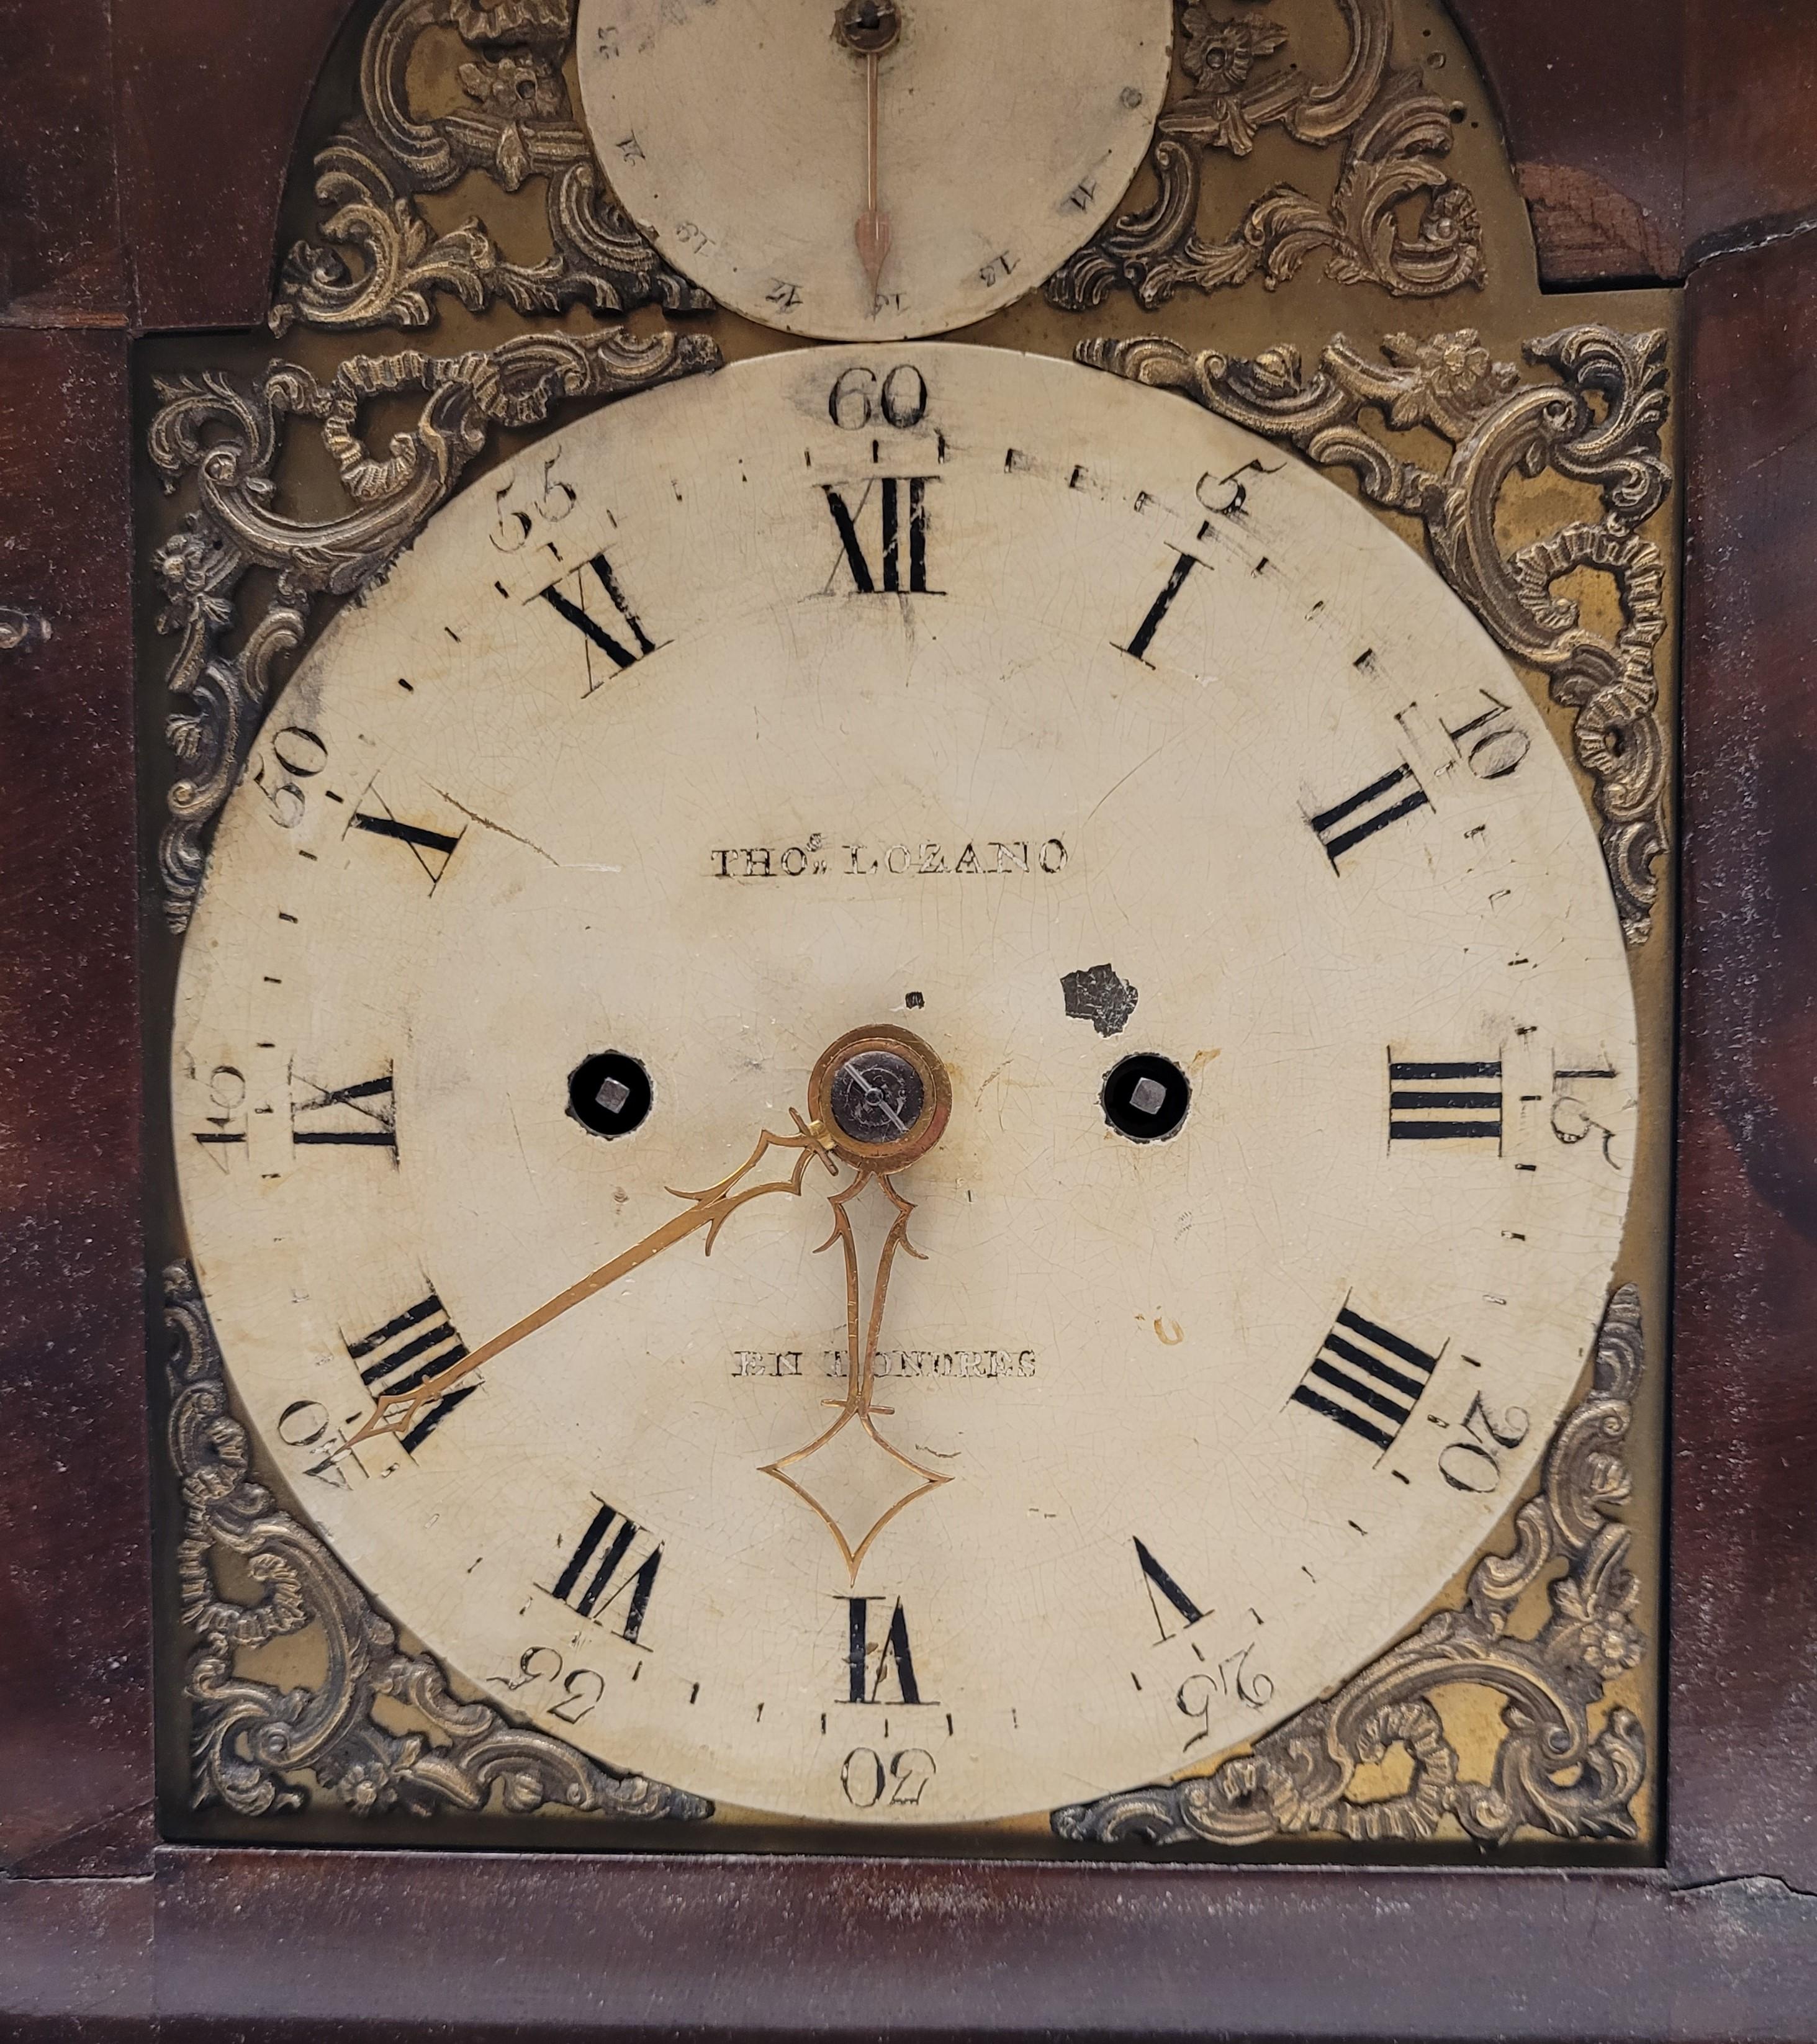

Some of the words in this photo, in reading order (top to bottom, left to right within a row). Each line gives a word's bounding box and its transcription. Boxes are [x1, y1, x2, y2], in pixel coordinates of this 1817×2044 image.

[828, 364, 928, 431] 60
[489, 444, 577, 553] 55
[800, 474, 947, 602] XII
[1195, 459, 1287, 514] 5
[522, 543, 675, 700] XI
[1109, 541, 1215, 670] I
[253, 726, 328, 829] 50
[1440, 688, 1531, 780] 10
[341, 768, 468, 899] X
[841, 838, 1069, 875] LOZANO
[1296, 747, 1436, 878] II
[184, 1047, 250, 1175] 45
[287, 1054, 400, 1173] IX
[1386, 1044, 1502, 1159] III
[1551, 1040, 1622, 1170] 15
[337, 1269, 487, 1467] VIII
[732, 1350, 803, 1377] EN
[1279, 1286, 1450, 1470] IIII
[277, 1399, 370, 1490] 40
[1430, 1390, 1530, 1493] 20
[533, 1490, 665, 1654] VII
[1132, 1535, 1215, 1647] V
[485, 1646, 606, 1725] 35
[832, 1594, 942, 1706] VI
[1176, 1642, 1274, 1753] 25
[840, 1747, 937, 1808] 30
